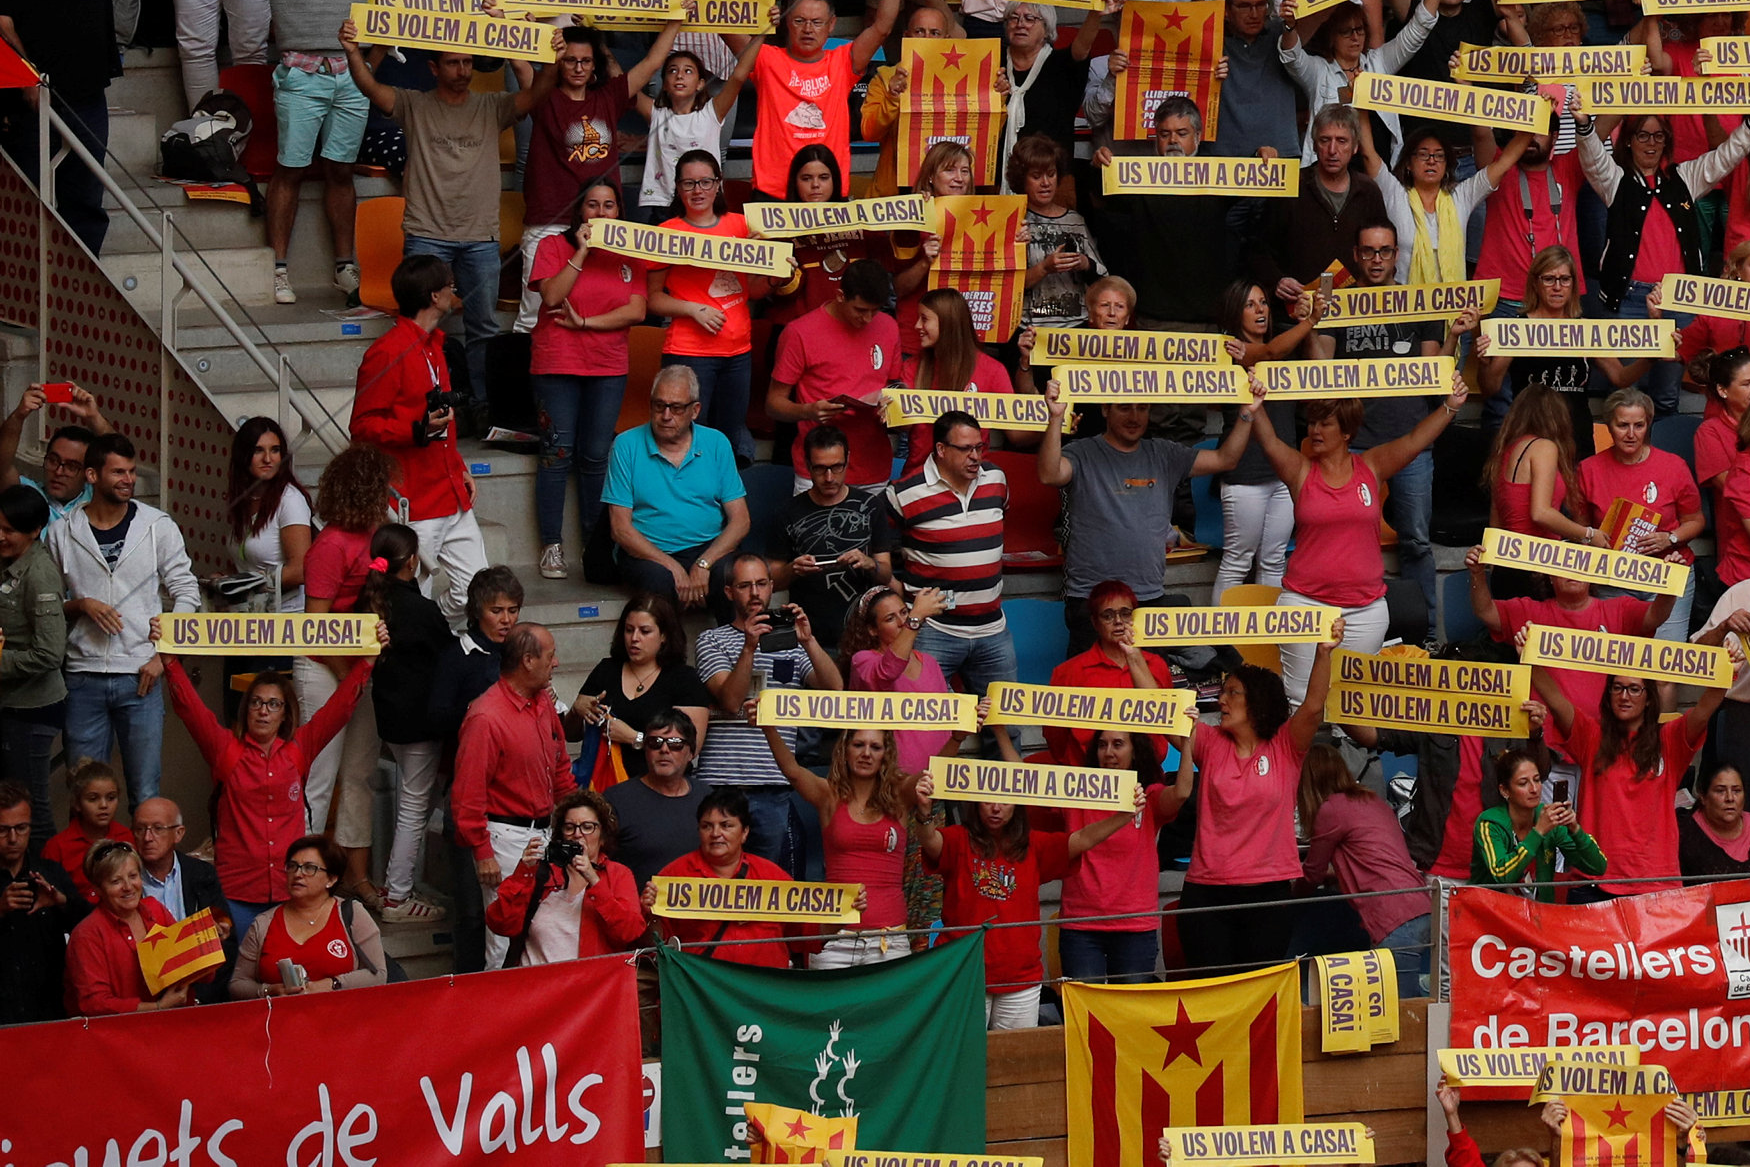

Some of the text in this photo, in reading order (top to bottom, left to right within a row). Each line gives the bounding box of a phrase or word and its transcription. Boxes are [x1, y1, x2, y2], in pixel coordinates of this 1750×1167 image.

[365, 9, 540, 51] US VOLEM A CASA!
[1370, 78, 1535, 122] US VOLEM A CASA!
[1346, 324, 1388, 339] FENYA
[1346, 337, 1390, 353] RAI!
[173, 618, 361, 645] US VOLEM A CASA!
[1144, 610, 1321, 636] US VOLEM A CASA!
[1340, 655, 1511, 694] US VOLEM A CASA!
[1471, 934, 1716, 980] Castellers
[1326, 957, 1354, 1032] A CASA!
[1734, 984, 1744, 993] de
[1473, 1014, 1530, 1049] de
[286, 1083, 377, 1167] de
[420, 1042, 603, 1156] Valls
